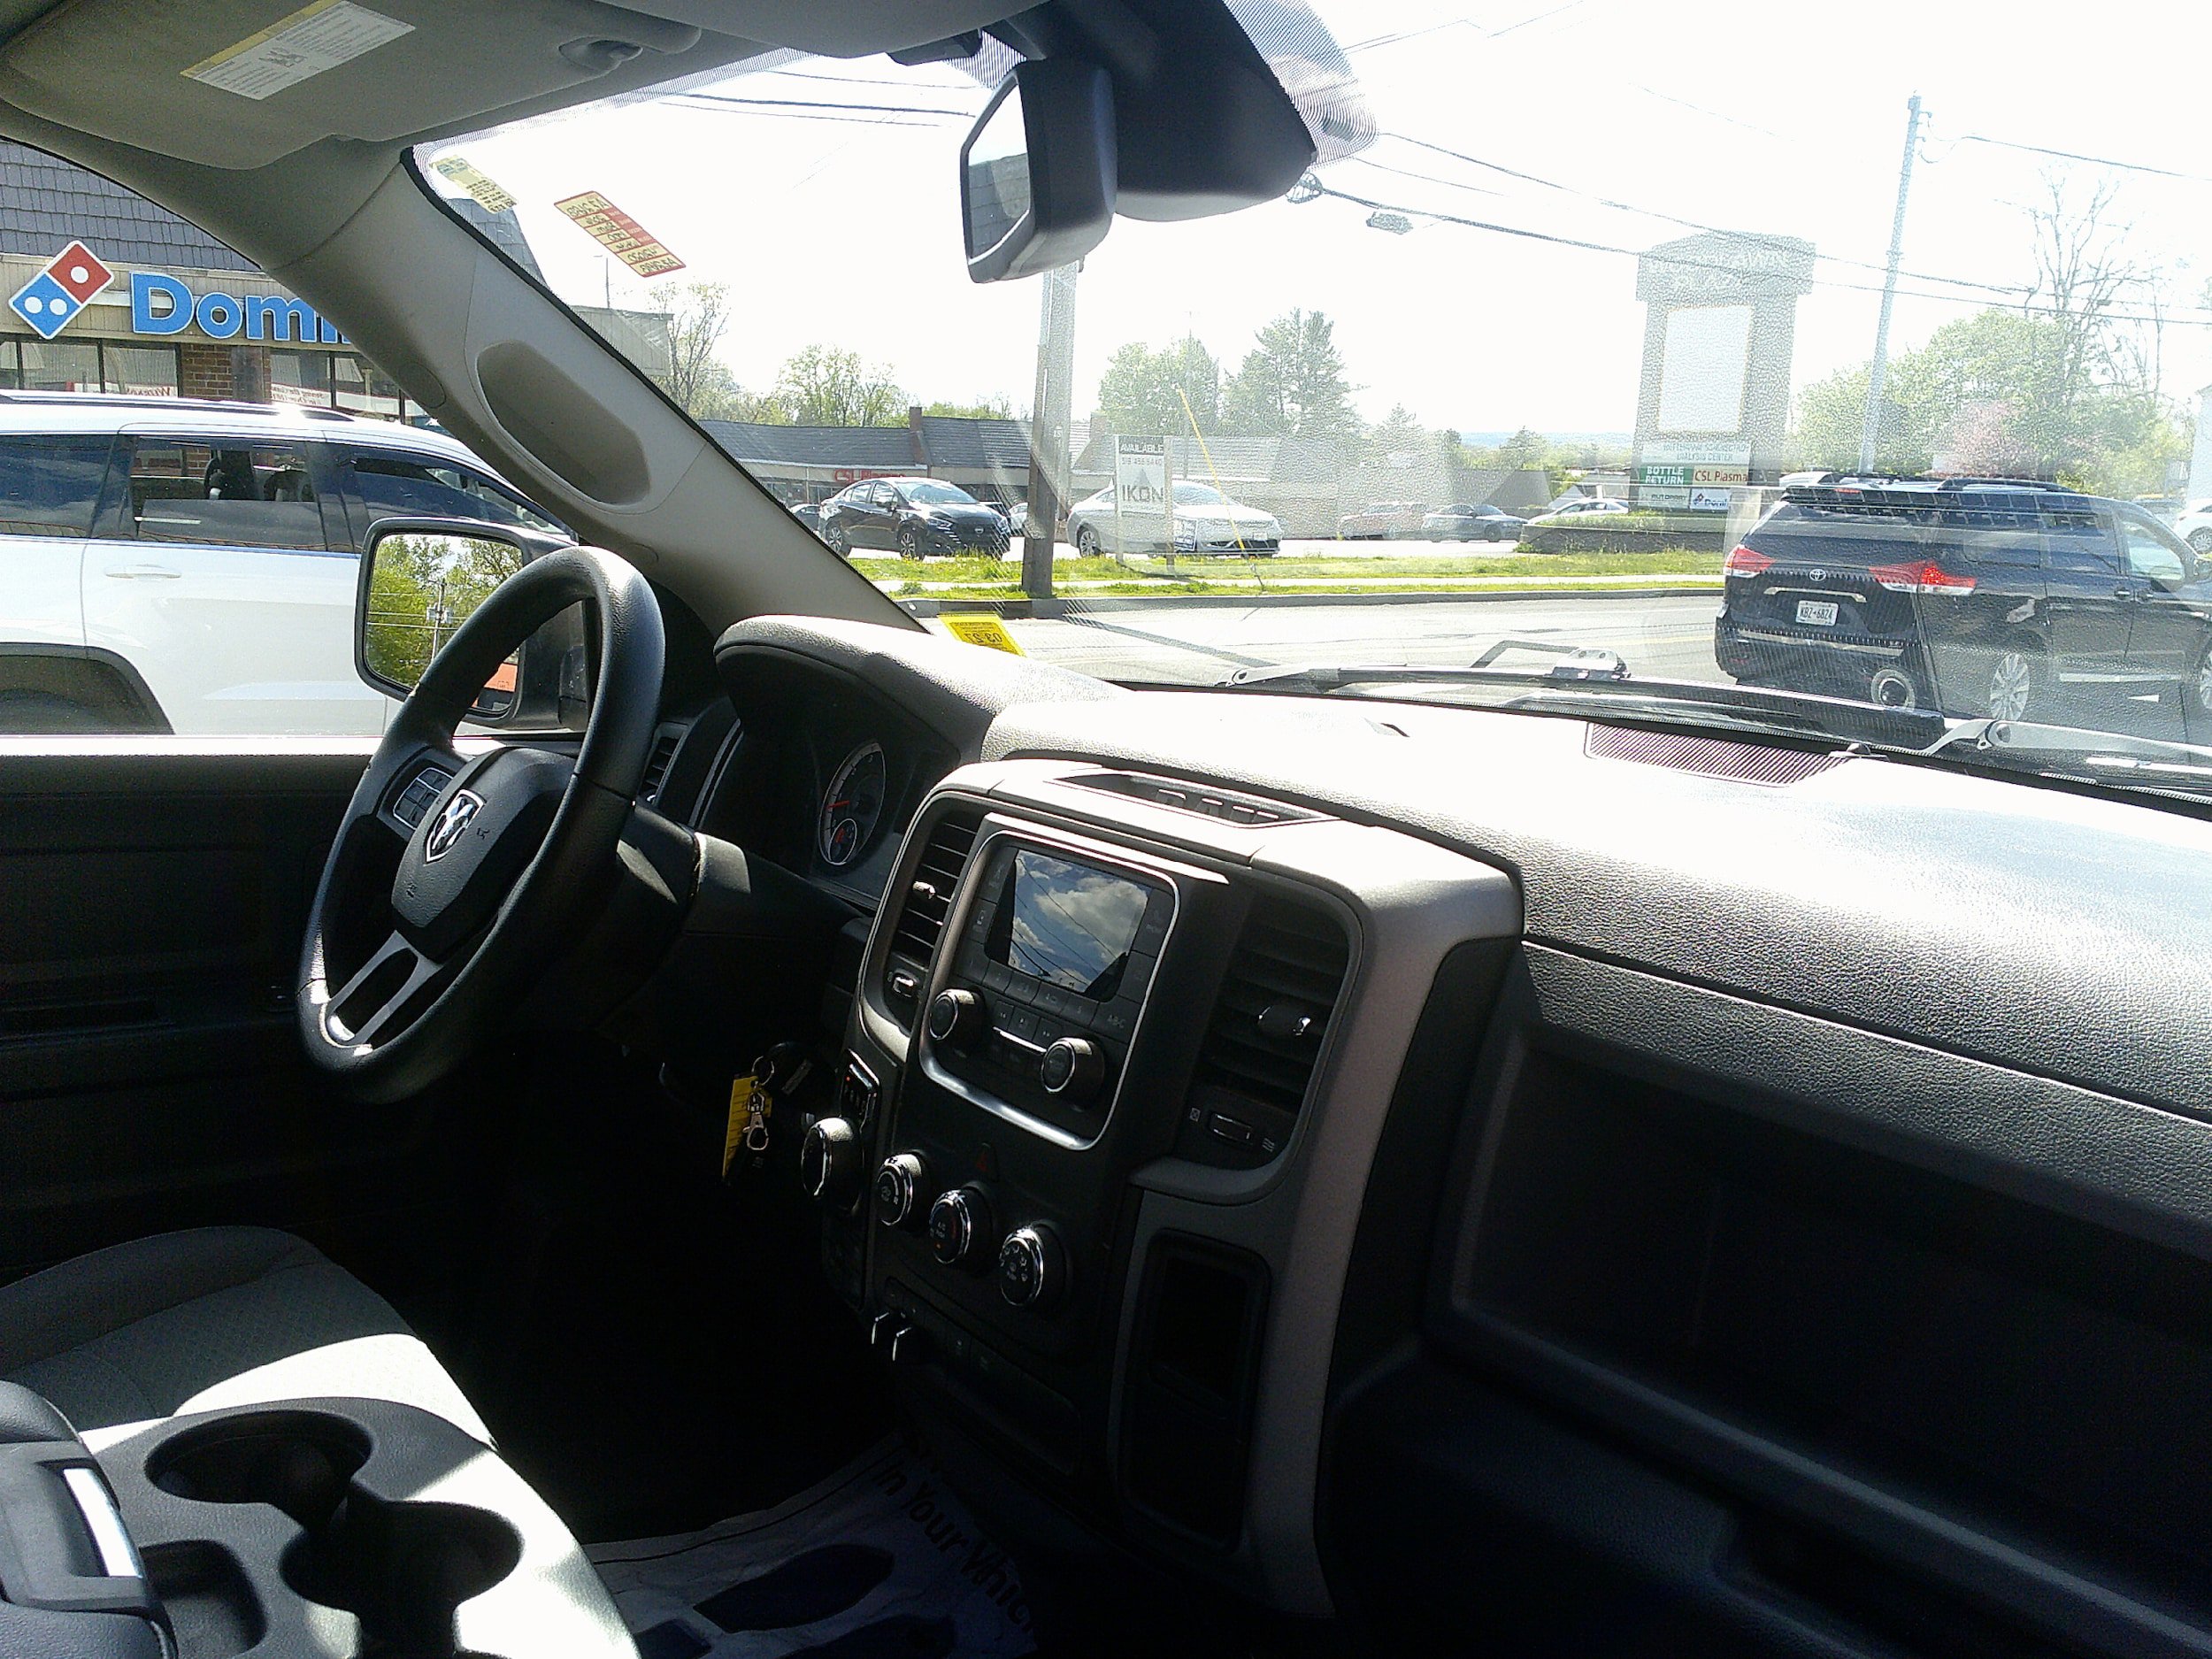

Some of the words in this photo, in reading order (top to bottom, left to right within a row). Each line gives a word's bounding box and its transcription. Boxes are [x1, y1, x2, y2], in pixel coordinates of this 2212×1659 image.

[129, 271, 352, 344] Dom
[1120, 443, 1164, 453] AVAILABLE
[1647, 466, 1685, 475] BOTTLE
[1694, 470, 1711, 481] CSL
[1715, 471, 1747, 482] Plasma
[1645, 475, 1684, 485] RETURN
[1122, 485, 1164, 503] IKON
[900, 1481, 969, 1553] Your
